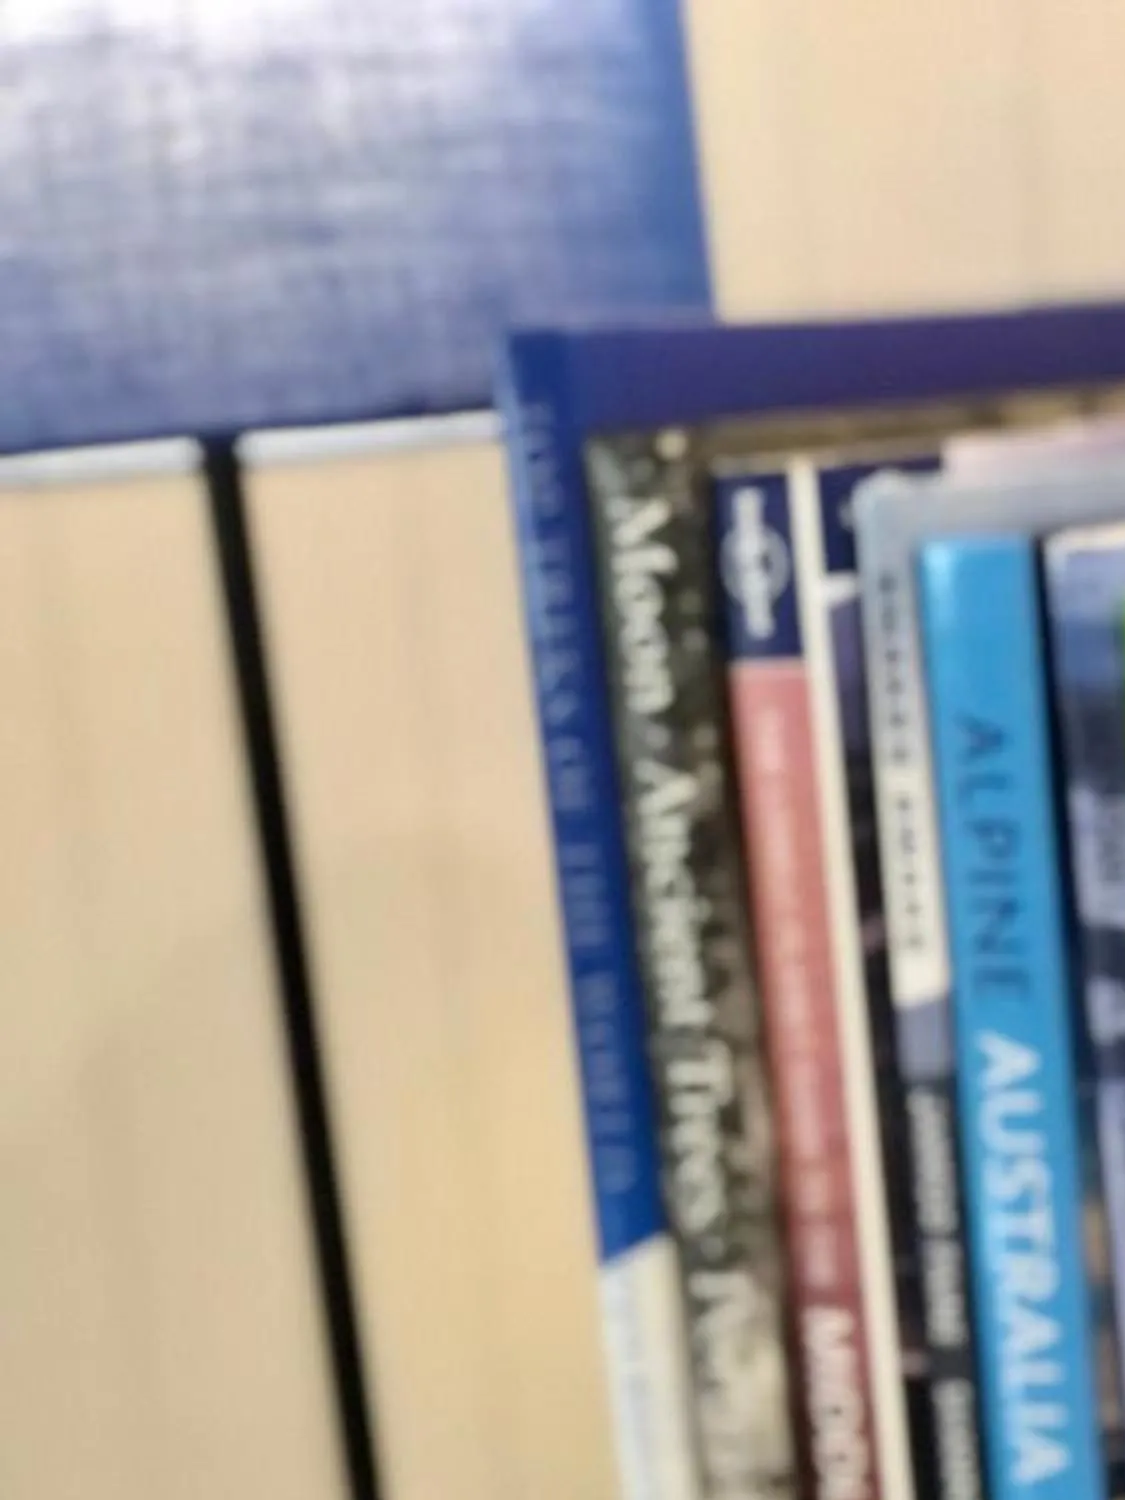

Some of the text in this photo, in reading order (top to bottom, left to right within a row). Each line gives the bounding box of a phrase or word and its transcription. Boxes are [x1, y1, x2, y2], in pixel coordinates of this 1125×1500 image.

[608, 492, 743, 1232] Moon Ancient Trees
[959, 716, 1031, 994] ALPINE
[980, 1034, 1064, 1483] AUSTRALIA
